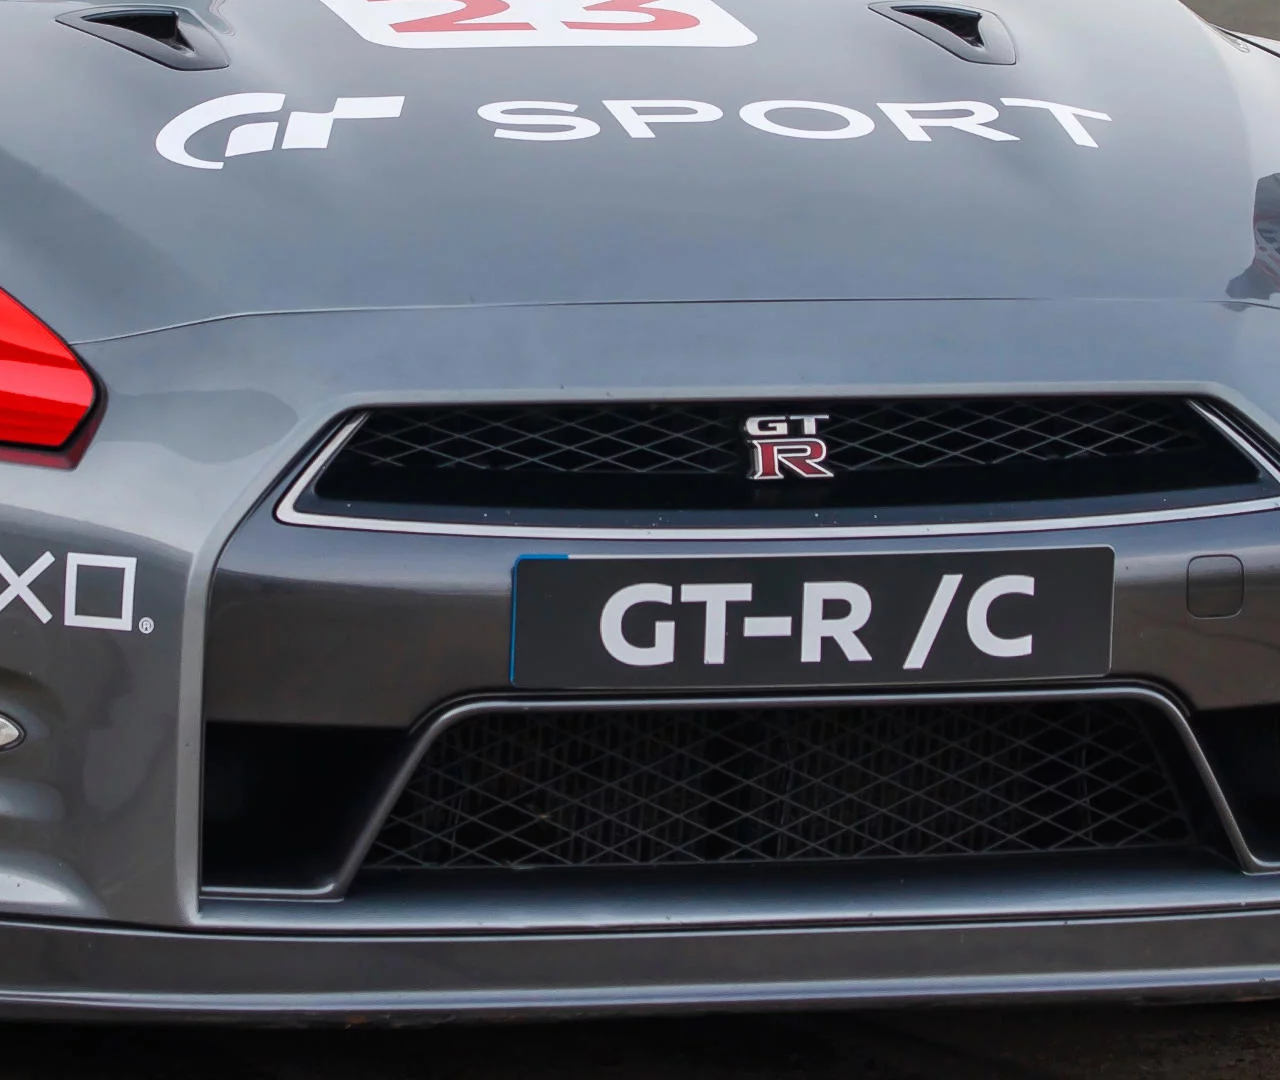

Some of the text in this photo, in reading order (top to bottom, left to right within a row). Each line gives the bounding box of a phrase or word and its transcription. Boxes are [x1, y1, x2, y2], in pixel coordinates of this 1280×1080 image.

[476, 98, 1113, 149] SPORT
[745, 414, 830, 436] GT
[749, 437, 835, 479] R
[599, 573, 1035, 670] GT-R /C
